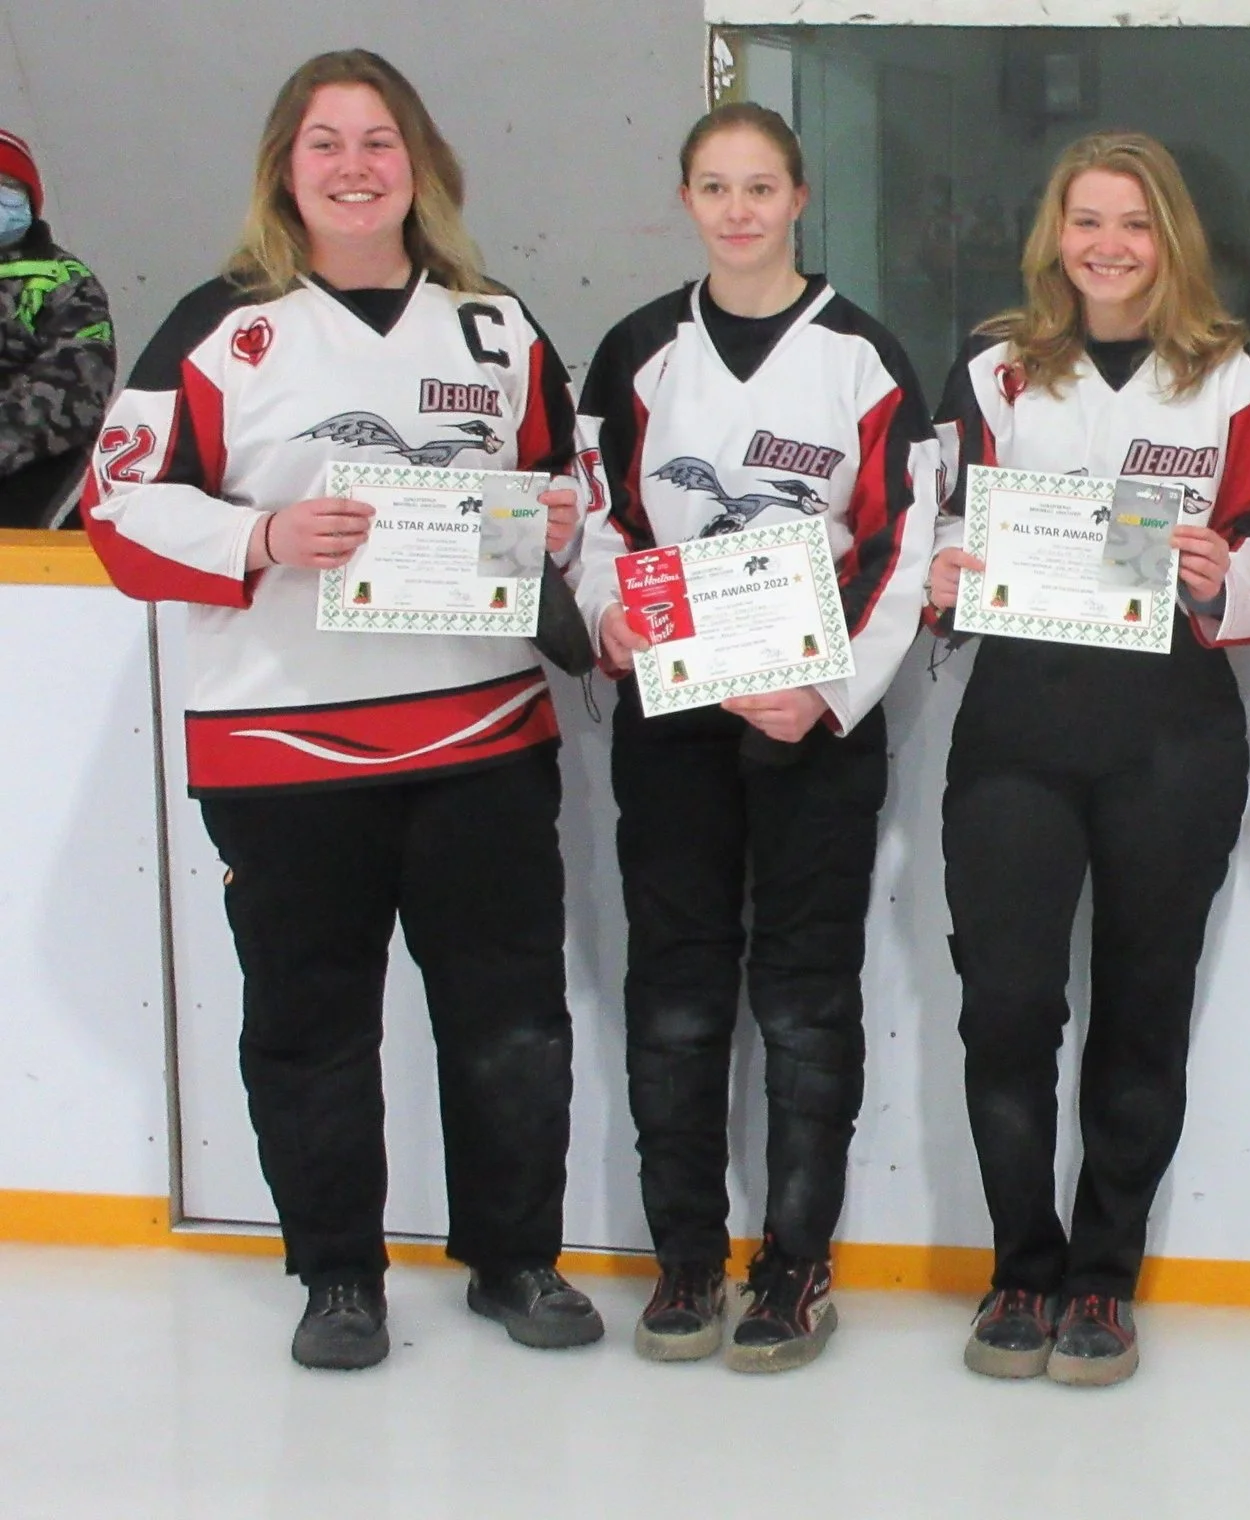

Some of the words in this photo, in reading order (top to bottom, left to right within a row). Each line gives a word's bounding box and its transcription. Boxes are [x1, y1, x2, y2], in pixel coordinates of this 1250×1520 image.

[457, 302, 510, 369] C
[1119, 438, 1219, 478] DEBDEN
[375, 520, 394, 530] ALL
[397, 521, 424, 531] STAR
[427, 523, 469, 533] AWARD
[1013, 523, 1031, 534] ALL
[1034, 525, 1060, 538] STAR
[1062, 529, 1104, 542] AWARD
[625, 577, 643, 590] Tim
[643, 573, 681, 587] Hortons
[692, 588, 719, 604] STAR
[720, 582, 762, 598] AWARD
[763, 576, 790, 590] 2022
